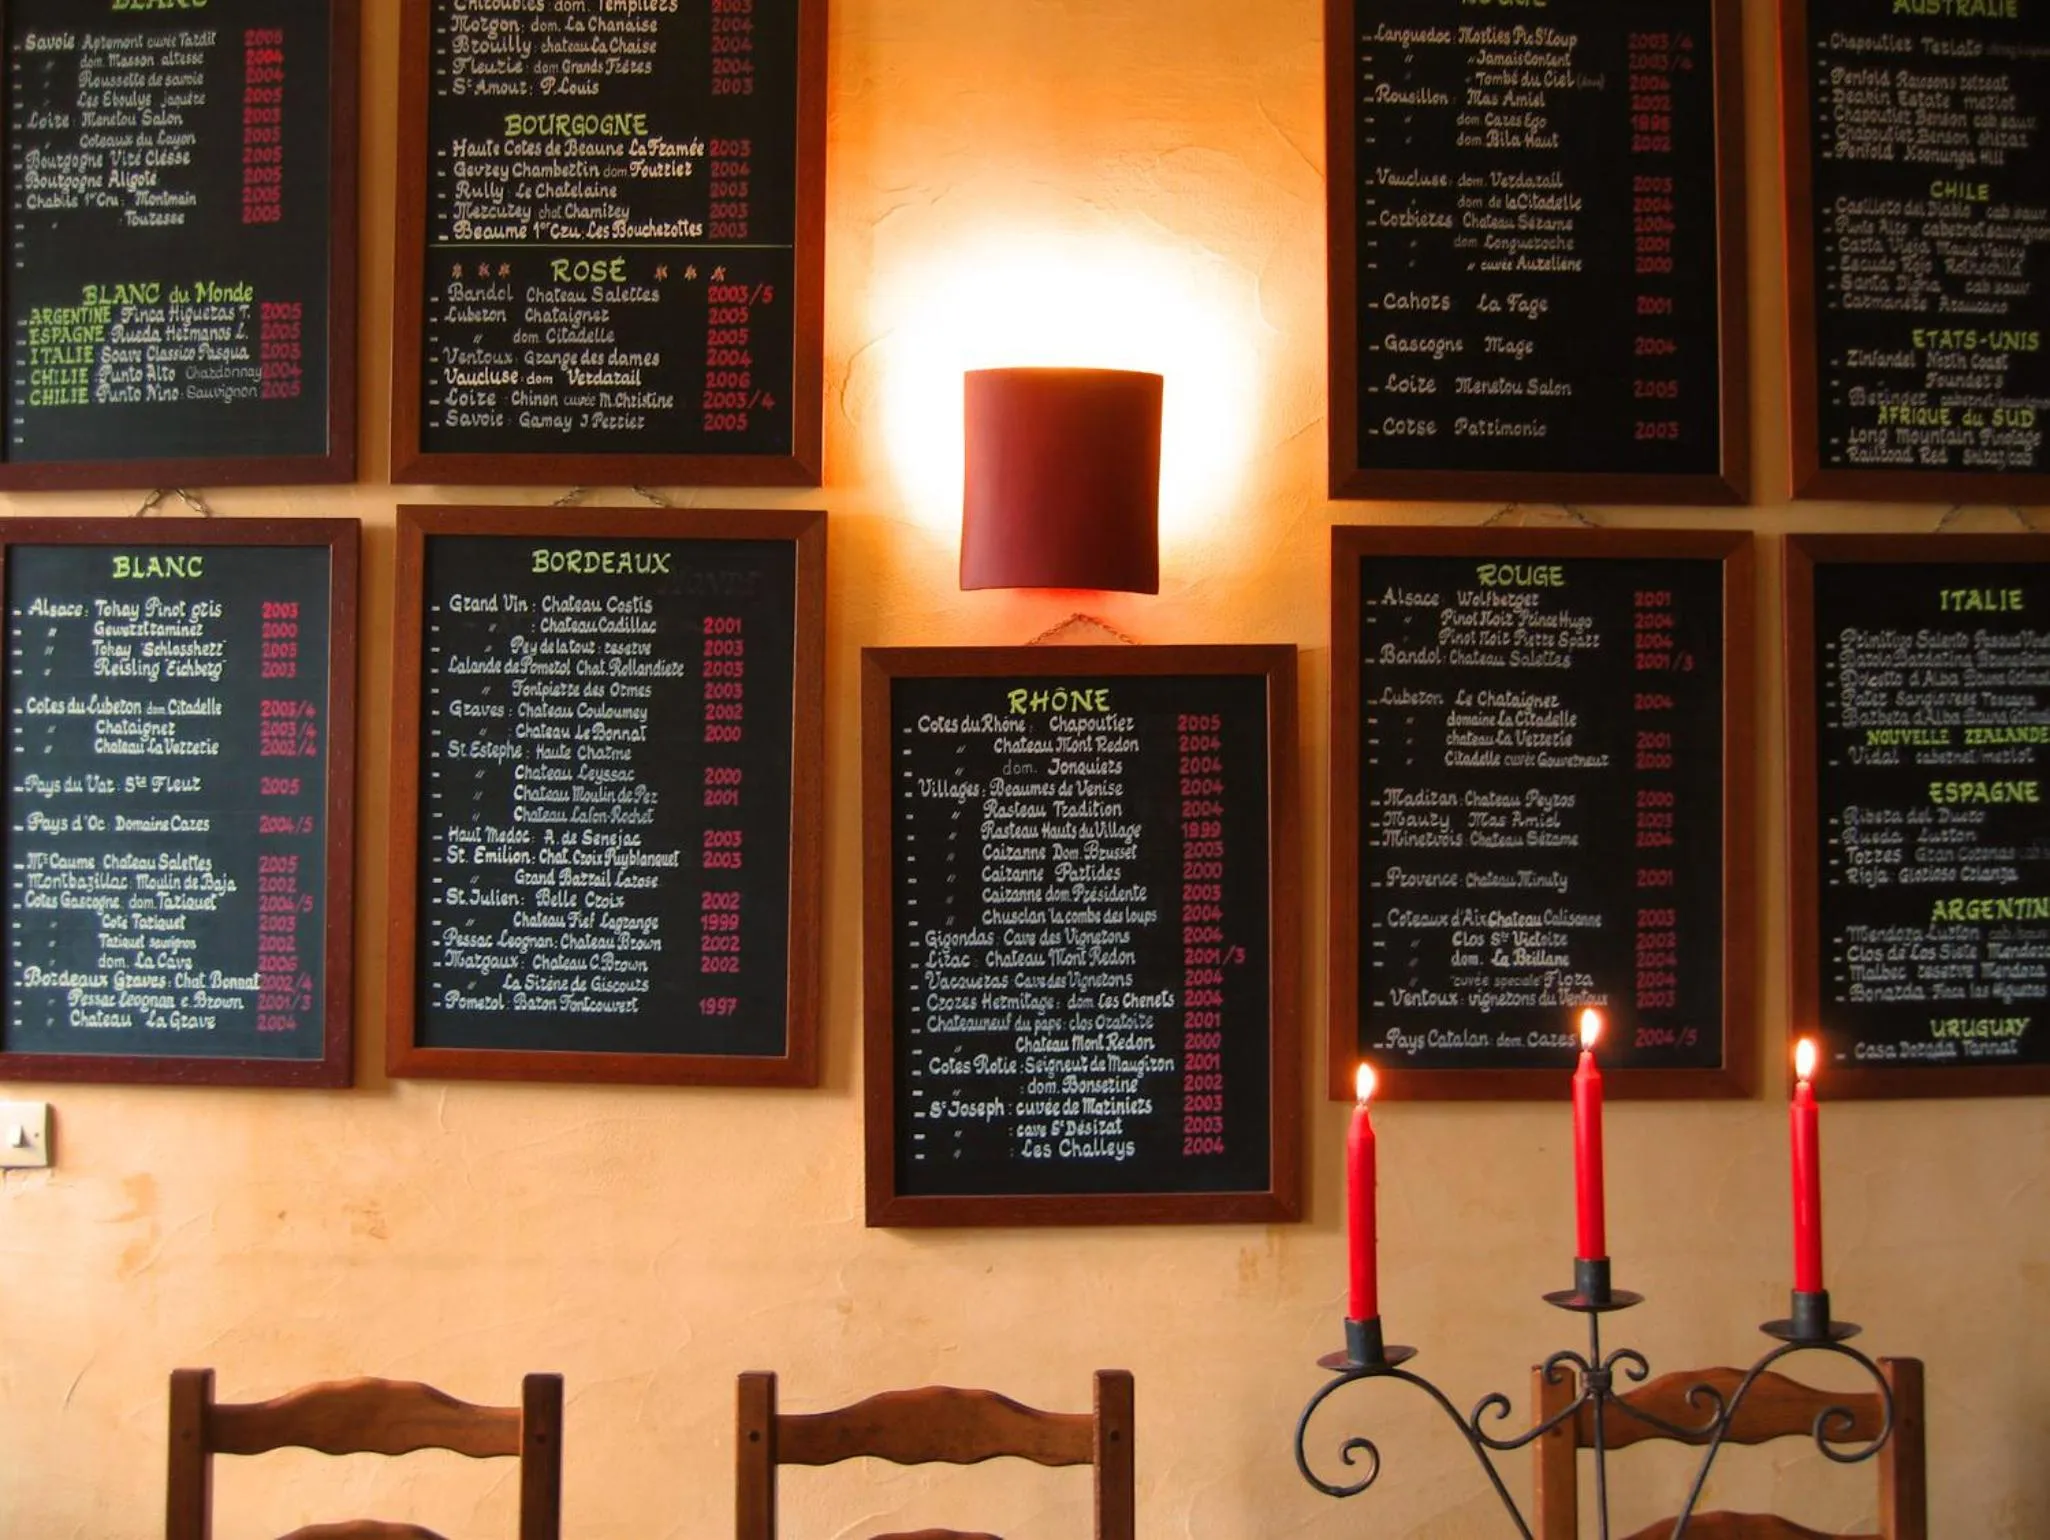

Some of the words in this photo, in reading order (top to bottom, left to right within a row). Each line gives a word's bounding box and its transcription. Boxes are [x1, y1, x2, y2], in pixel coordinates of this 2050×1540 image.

[712, 38, 753, 53] 2004
[712, 59, 753, 74] 2004
[504, 113, 648, 137] BOURGOGNE
[453, 140, 500, 156] Haute
[709, 139, 751, 156] 2003
[455, 183, 503, 204] Rully
[1930, 181, 1989, 201] CHILE
[551, 256, 626, 283] ROSÉ
[82, 282, 161, 306] BLANC
[195, 281, 253, 303] Monde
[1383, 292, 1452, 311] Cahors
[29, 305, 111, 325] ARGENTINE
[29, 326, 104, 345] ESPAGNE
[1912, 329, 2039, 350] ETATS-UNIS
[30, 346, 93, 365] ITALIE
[704, 413, 748, 431] 2005
[1878, 405, 1952, 426] AFRIQUE
[1992, 408, 2036, 427] SUD
[1383, 416, 1438, 436] Corse
[1634, 422, 1680, 440] 2003
[113, 555, 204, 579] BLANC
[532, 549, 671, 574] BORDEAUX
[1476, 564, 1565, 588] ROUGE
[449, 594, 498, 613] Grand
[542, 595, 602, 613] Chateau
[1940, 589, 2024, 612] ITALIE
[541, 617, 599, 634] Chateau
[599, 616, 657, 634] Cadillac
[703, 616, 742, 634] 2001
[449, 655, 501, 675] Lalande
[1007, 687, 1111, 715] RHÔNE
[517, 702, 573, 719] Chateau
[705, 704, 743, 721] 2002
[918, 715, 959, 734] Cotes
[1050, 714, 1135, 738] Chapoutier
[1177, 714, 1221, 731] 2005
[994, 737, 1053, 754] Chateau
[1054, 736, 1092, 754] Mont
[1096, 737, 1139, 753] Redon
[1179, 735, 1221, 752] 2004
[1867, 728, 1950, 746] NOUVELLE
[515, 764, 573, 781] Chateau
[705, 767, 741, 785] 2000
[1058, 780, 1074, 796] de
[1076, 779, 1124, 797] Venise
[1180, 779, 1224, 795] 2004
[1929, 781, 2040, 804] ESPAGNE
[983, 800, 1047, 820] Rasteau
[1053, 801, 1123, 818] Tradition
[1182, 801, 1224, 818] 2004
[515, 869, 555, 886] Grand
[1183, 862, 1223, 880] 2000
[536, 890, 577, 908] Belle
[585, 891, 625, 909] Croix
[702, 892, 740, 910] 2002
[513, 912, 566, 929] Chateau
[1003, 930, 1036, 947] Cave
[1039, 930, 1062, 947] des
[1065, 928, 1130, 951] Vignerons
[1183, 928, 1223, 943] 2004
[699, 998, 737, 1015] 1997
[1930, 1017, 2031, 1038] URUGUAY
[1021, 1142, 1052, 1159] Les
[1059, 1140, 1136, 1161] Challeys
[1182, 1137, 1224, 1156] 2004
